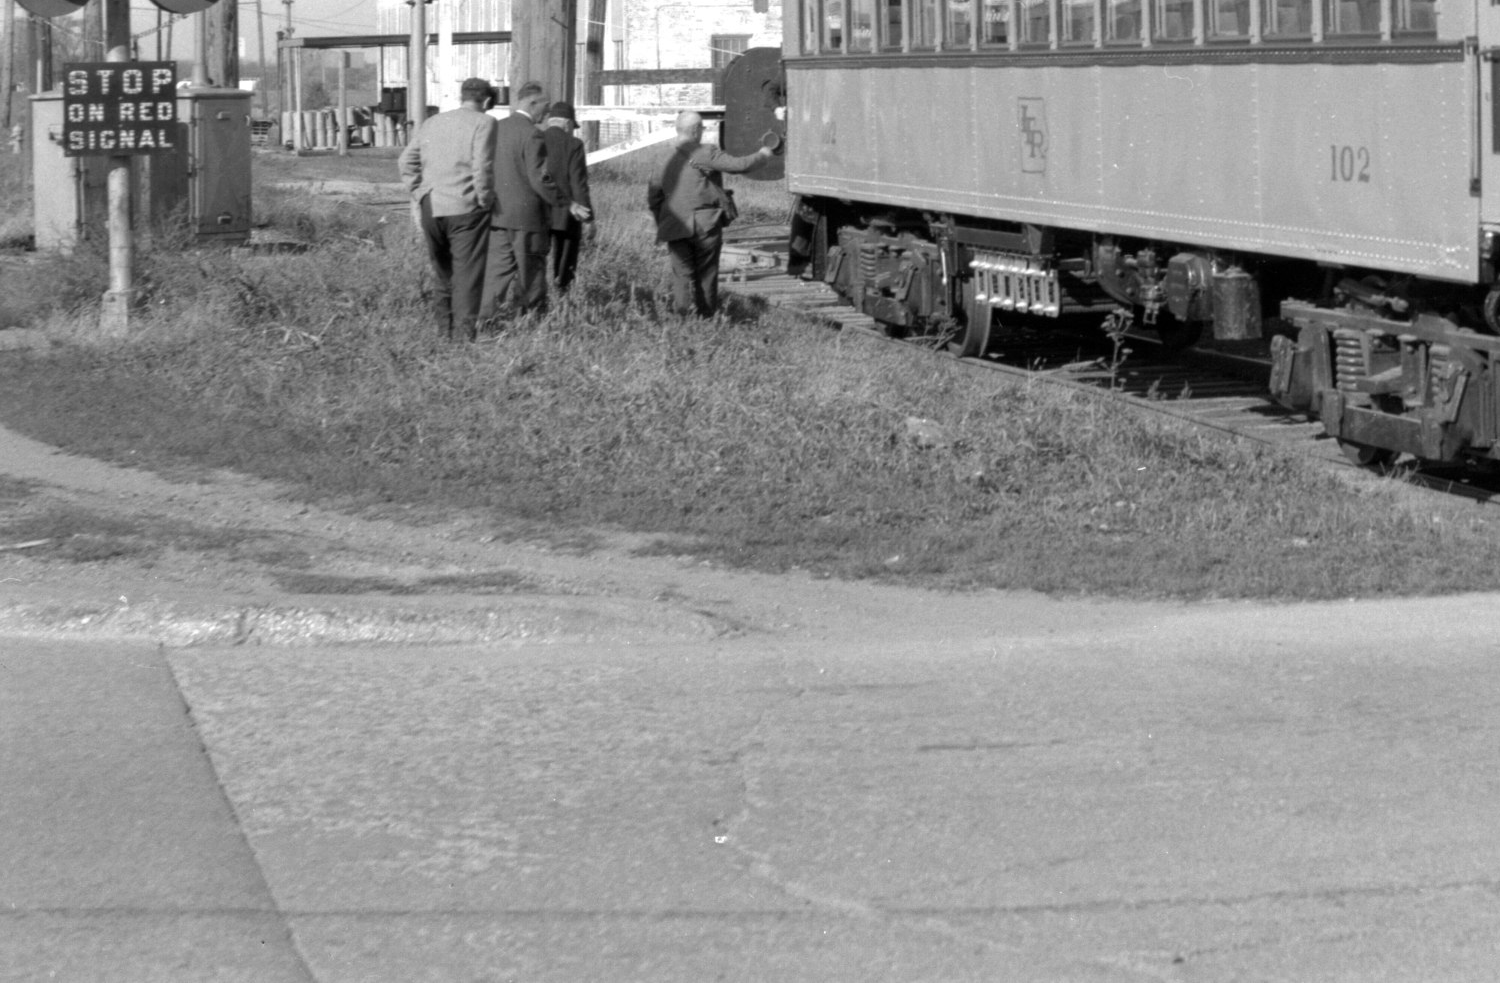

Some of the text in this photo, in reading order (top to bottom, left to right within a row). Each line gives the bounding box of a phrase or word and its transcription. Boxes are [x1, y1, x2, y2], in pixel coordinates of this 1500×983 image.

[68, 69, 173, 95] STOP
[68, 102, 173, 122] ON RED
[69, 129, 173, 150] SIGNAL
[1330, 144, 1370, 183] 102
